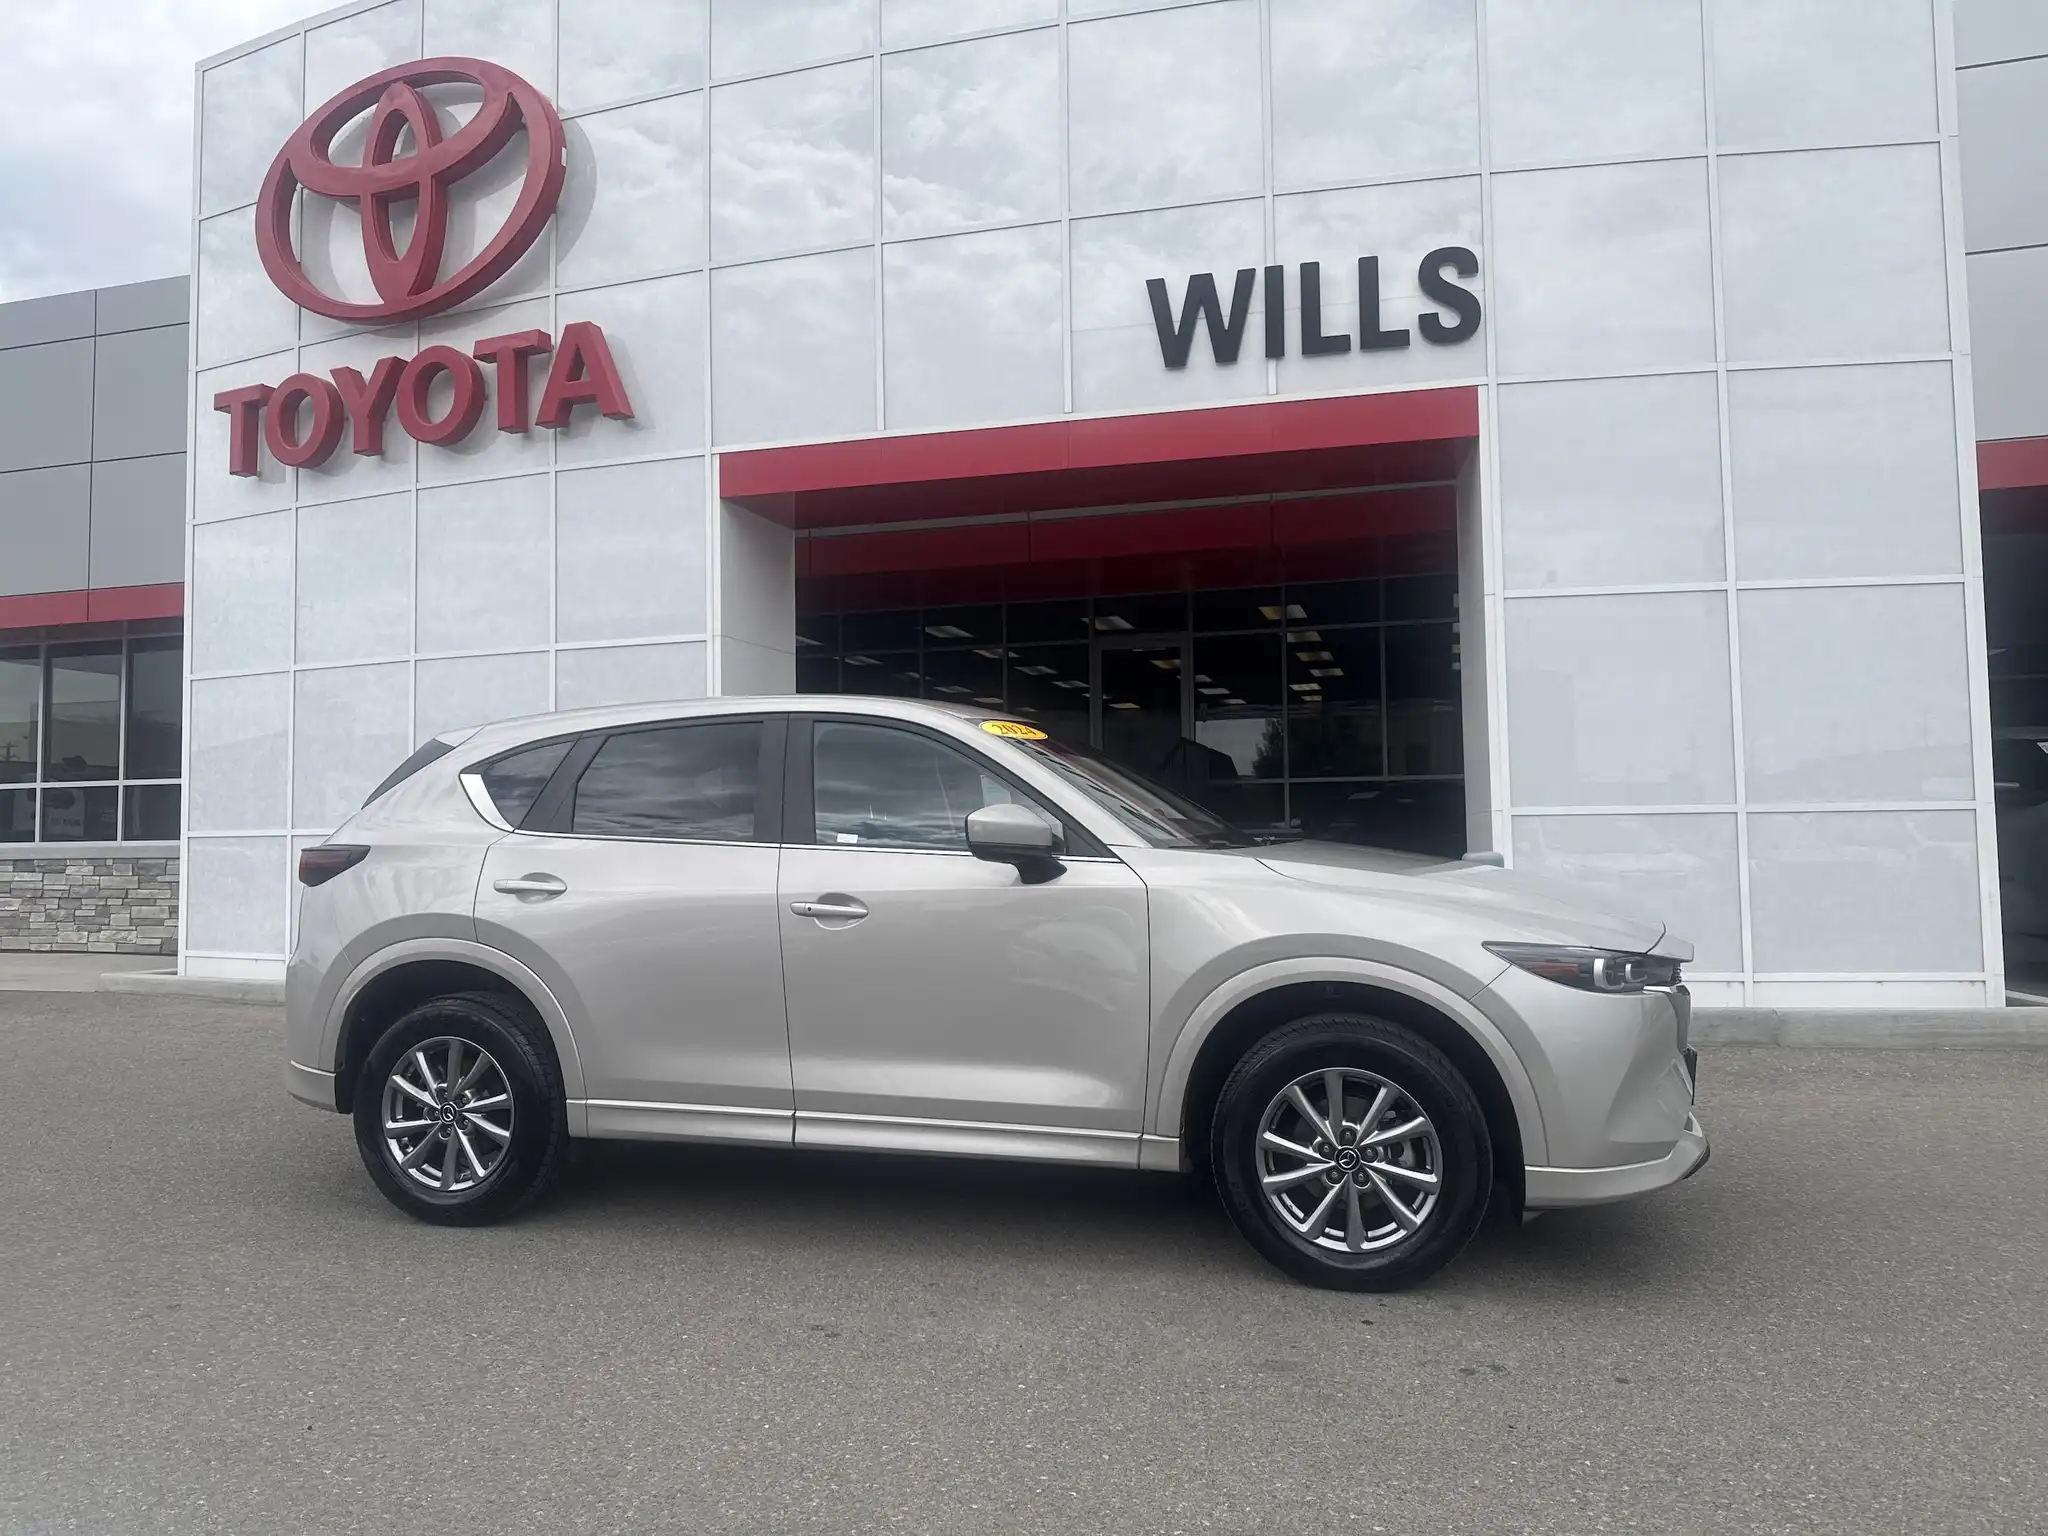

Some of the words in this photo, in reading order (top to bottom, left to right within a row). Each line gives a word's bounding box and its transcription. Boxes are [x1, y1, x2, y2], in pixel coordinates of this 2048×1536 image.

[1146, 246, 1482, 368] WILLS
[214, 321, 634, 476] TOYOTA
[991, 724, 1037, 735] 2024
